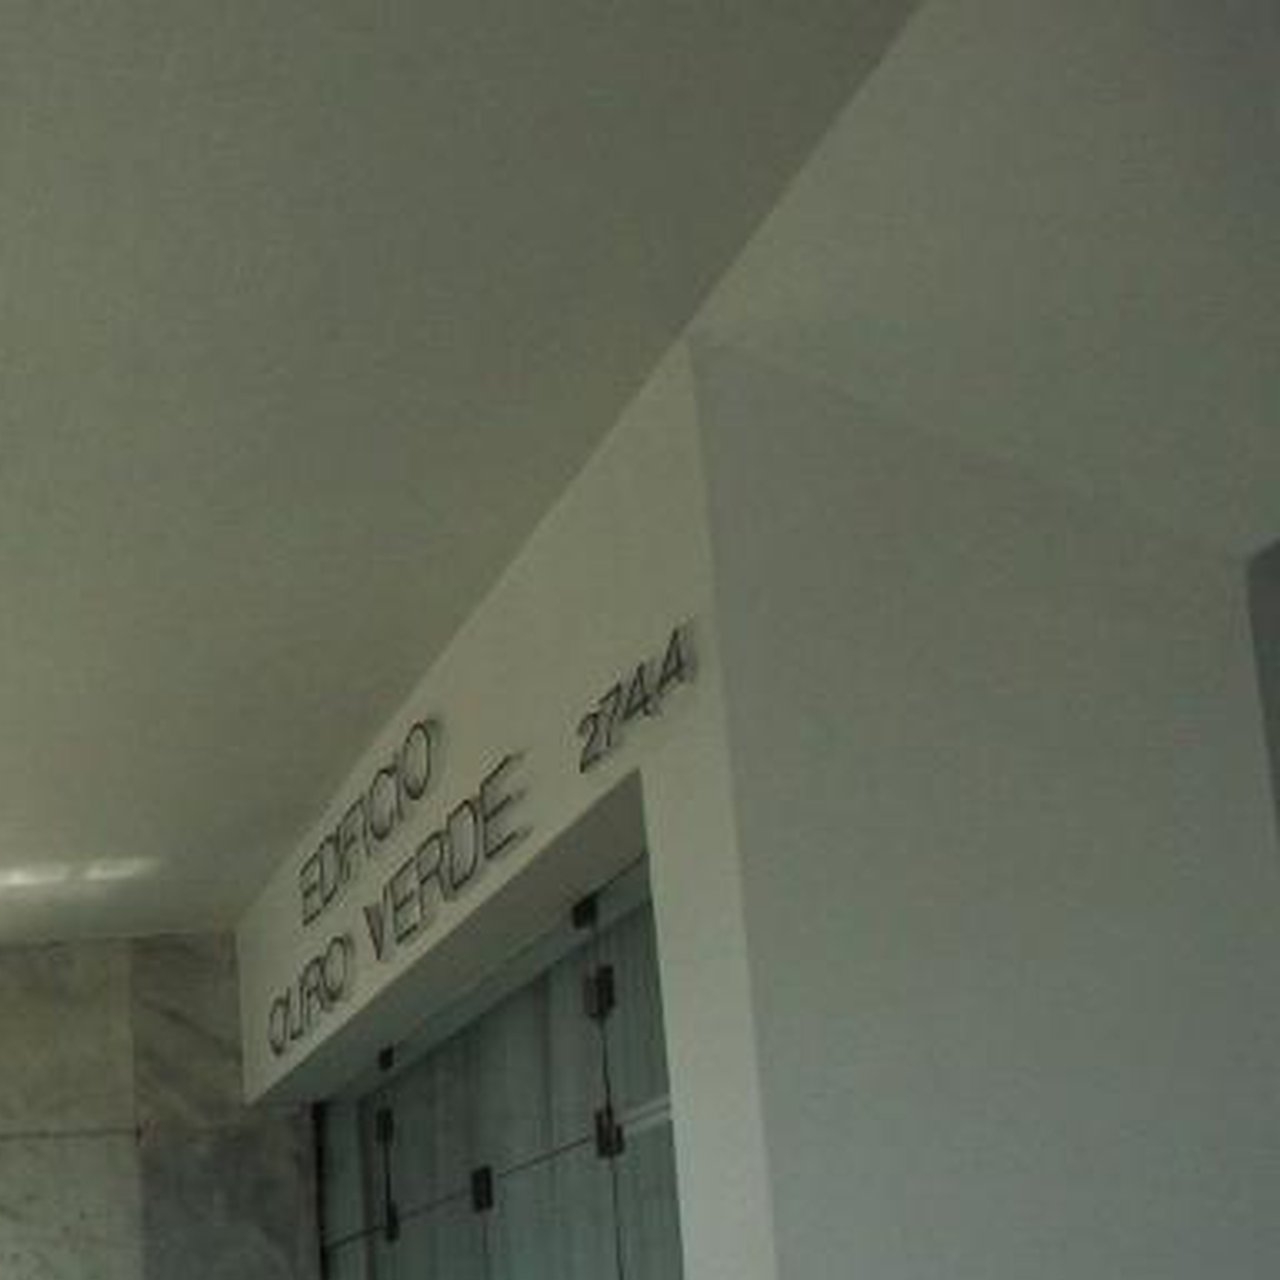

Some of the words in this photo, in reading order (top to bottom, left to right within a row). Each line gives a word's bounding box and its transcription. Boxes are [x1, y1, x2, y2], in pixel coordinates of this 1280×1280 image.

[577, 628, 685, 774] 2744
[269, 935, 349, 1056] OURO
[362, 755, 524, 960] VERDE
